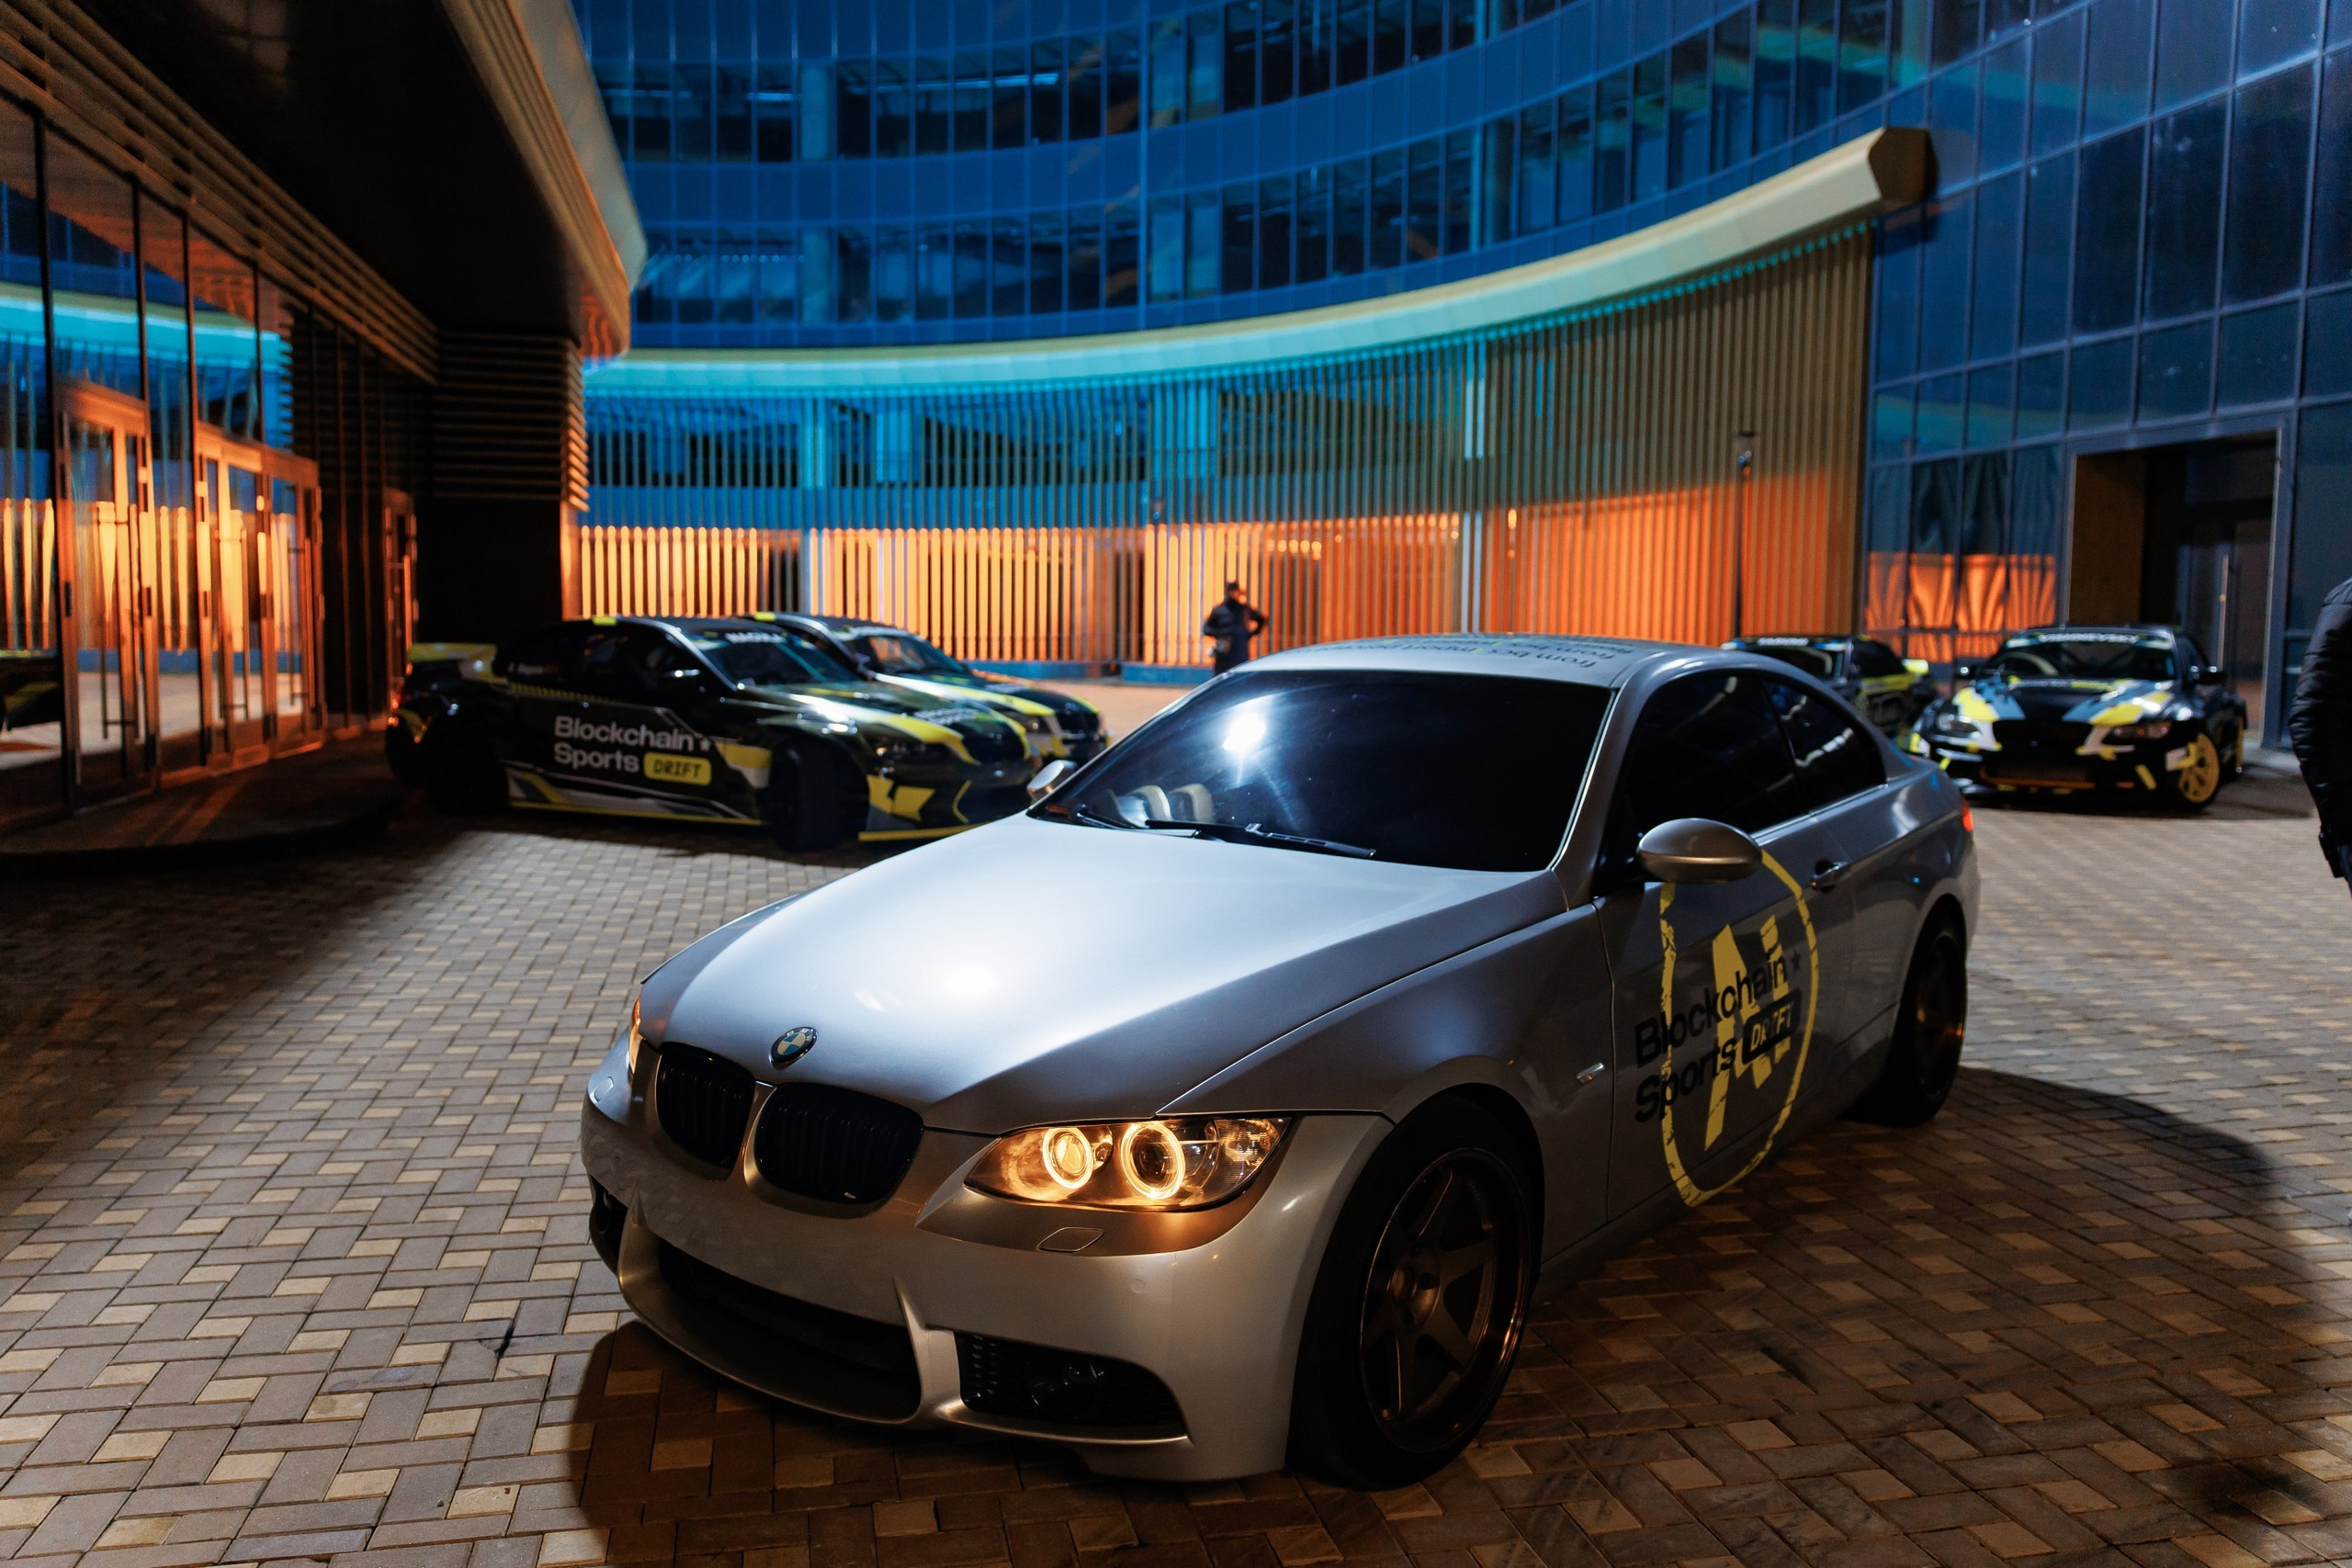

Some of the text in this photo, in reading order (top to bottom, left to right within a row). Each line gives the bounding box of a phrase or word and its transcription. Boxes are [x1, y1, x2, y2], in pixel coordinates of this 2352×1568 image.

[1536, 653, 1597, 668] from
[555, 715, 695, 752] Blockchain
[554, 741, 703, 779] Sports DRIFT
[1634, 953, 1788, 1068] Blockchain
[1635, 1037, 1737, 1122] Sports
